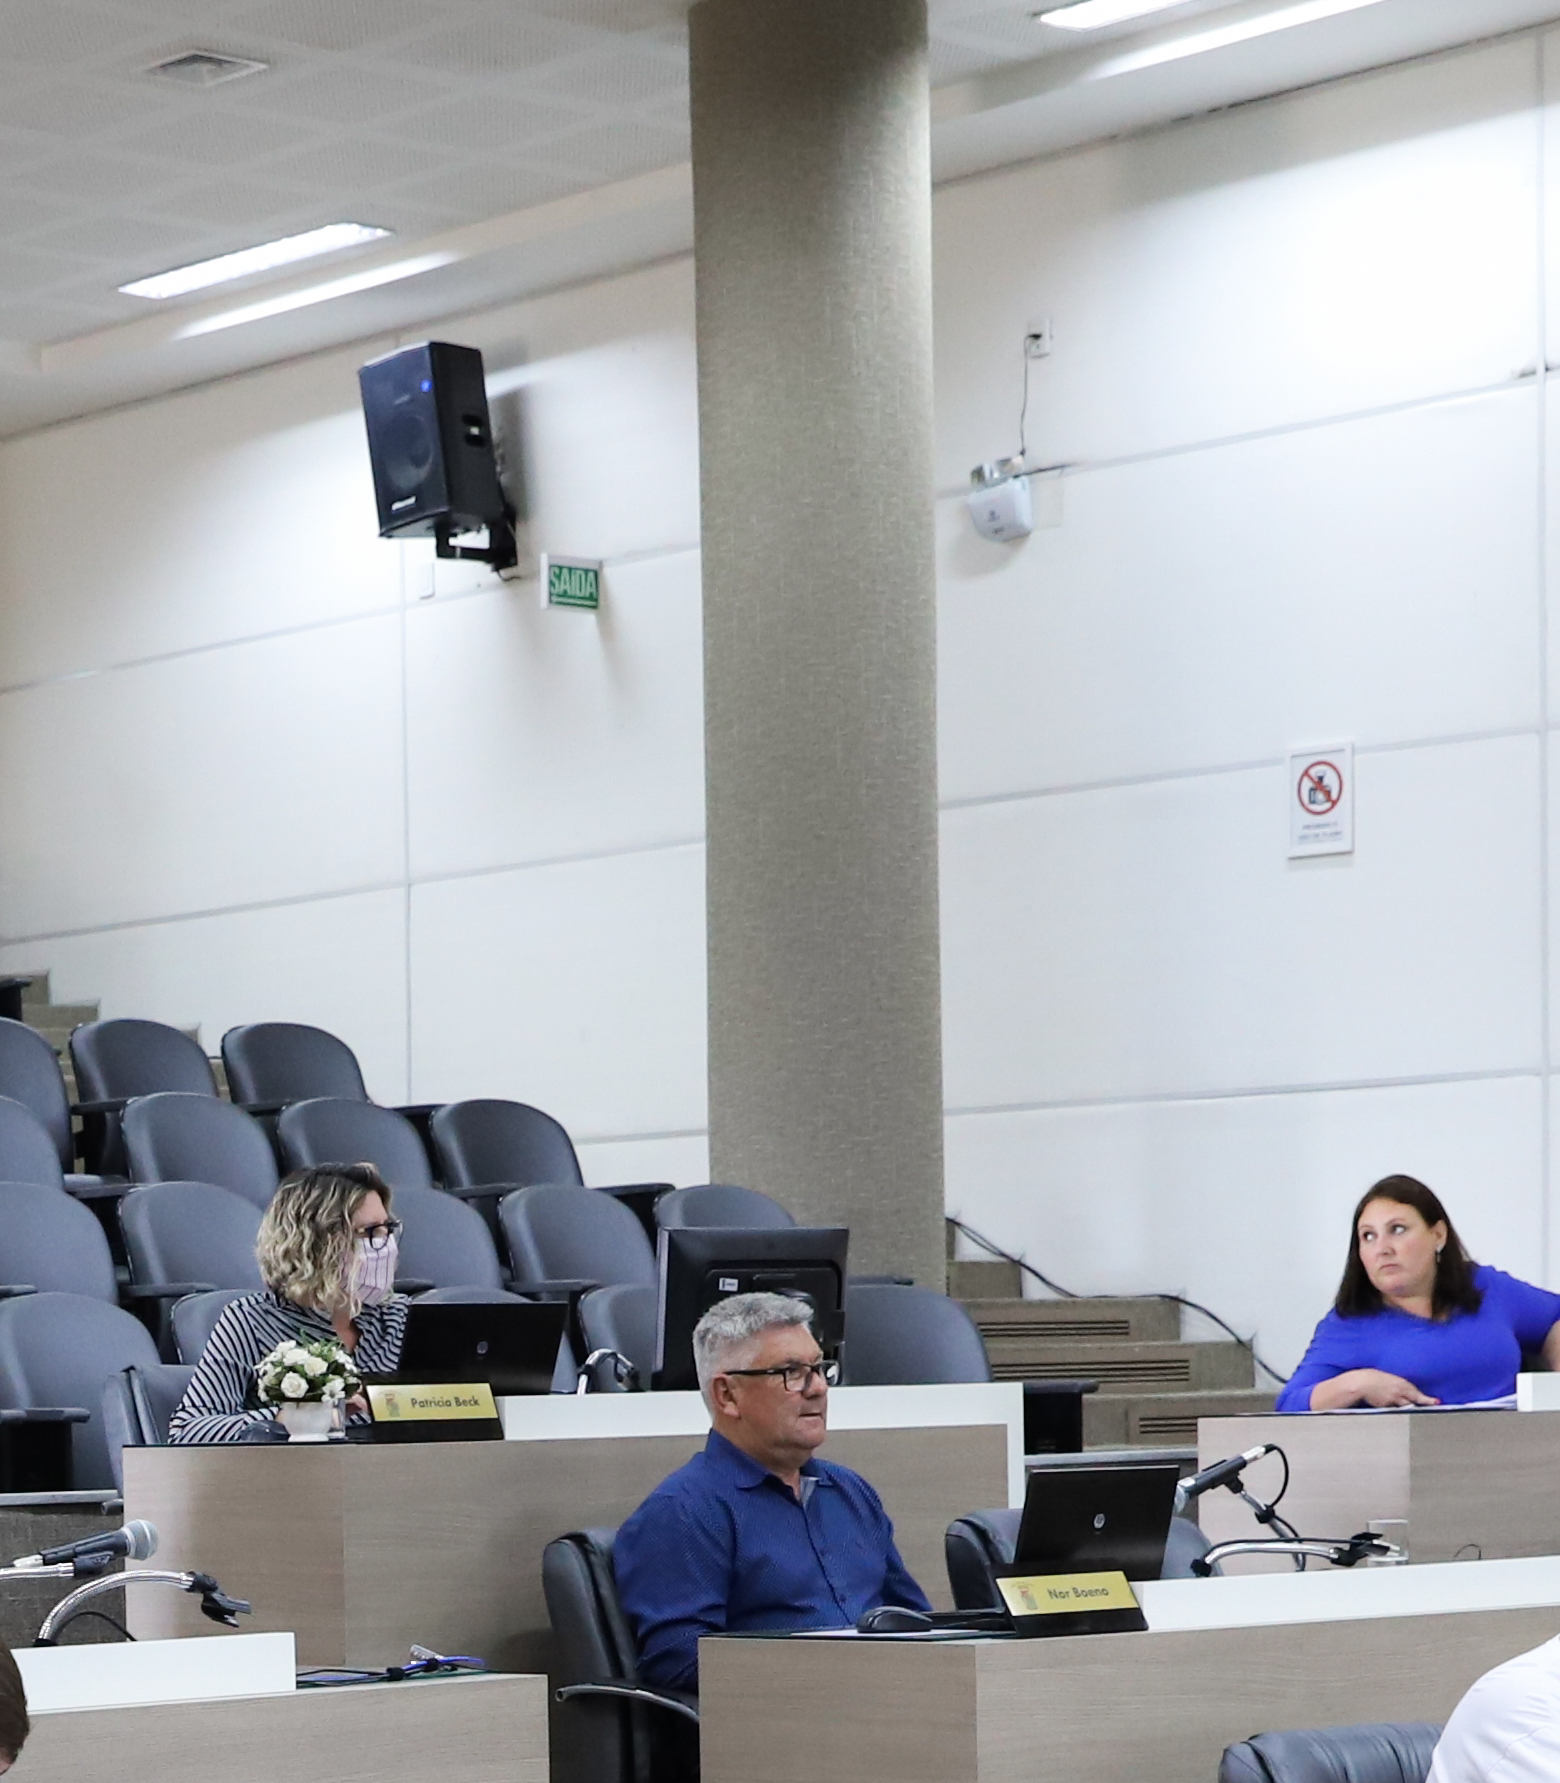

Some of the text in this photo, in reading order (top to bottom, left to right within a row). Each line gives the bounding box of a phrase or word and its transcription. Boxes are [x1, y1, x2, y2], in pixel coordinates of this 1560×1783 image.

[455, 1395, 480, 1407] Beck
[1047, 1586, 1109, 1600] Nor Boeno
